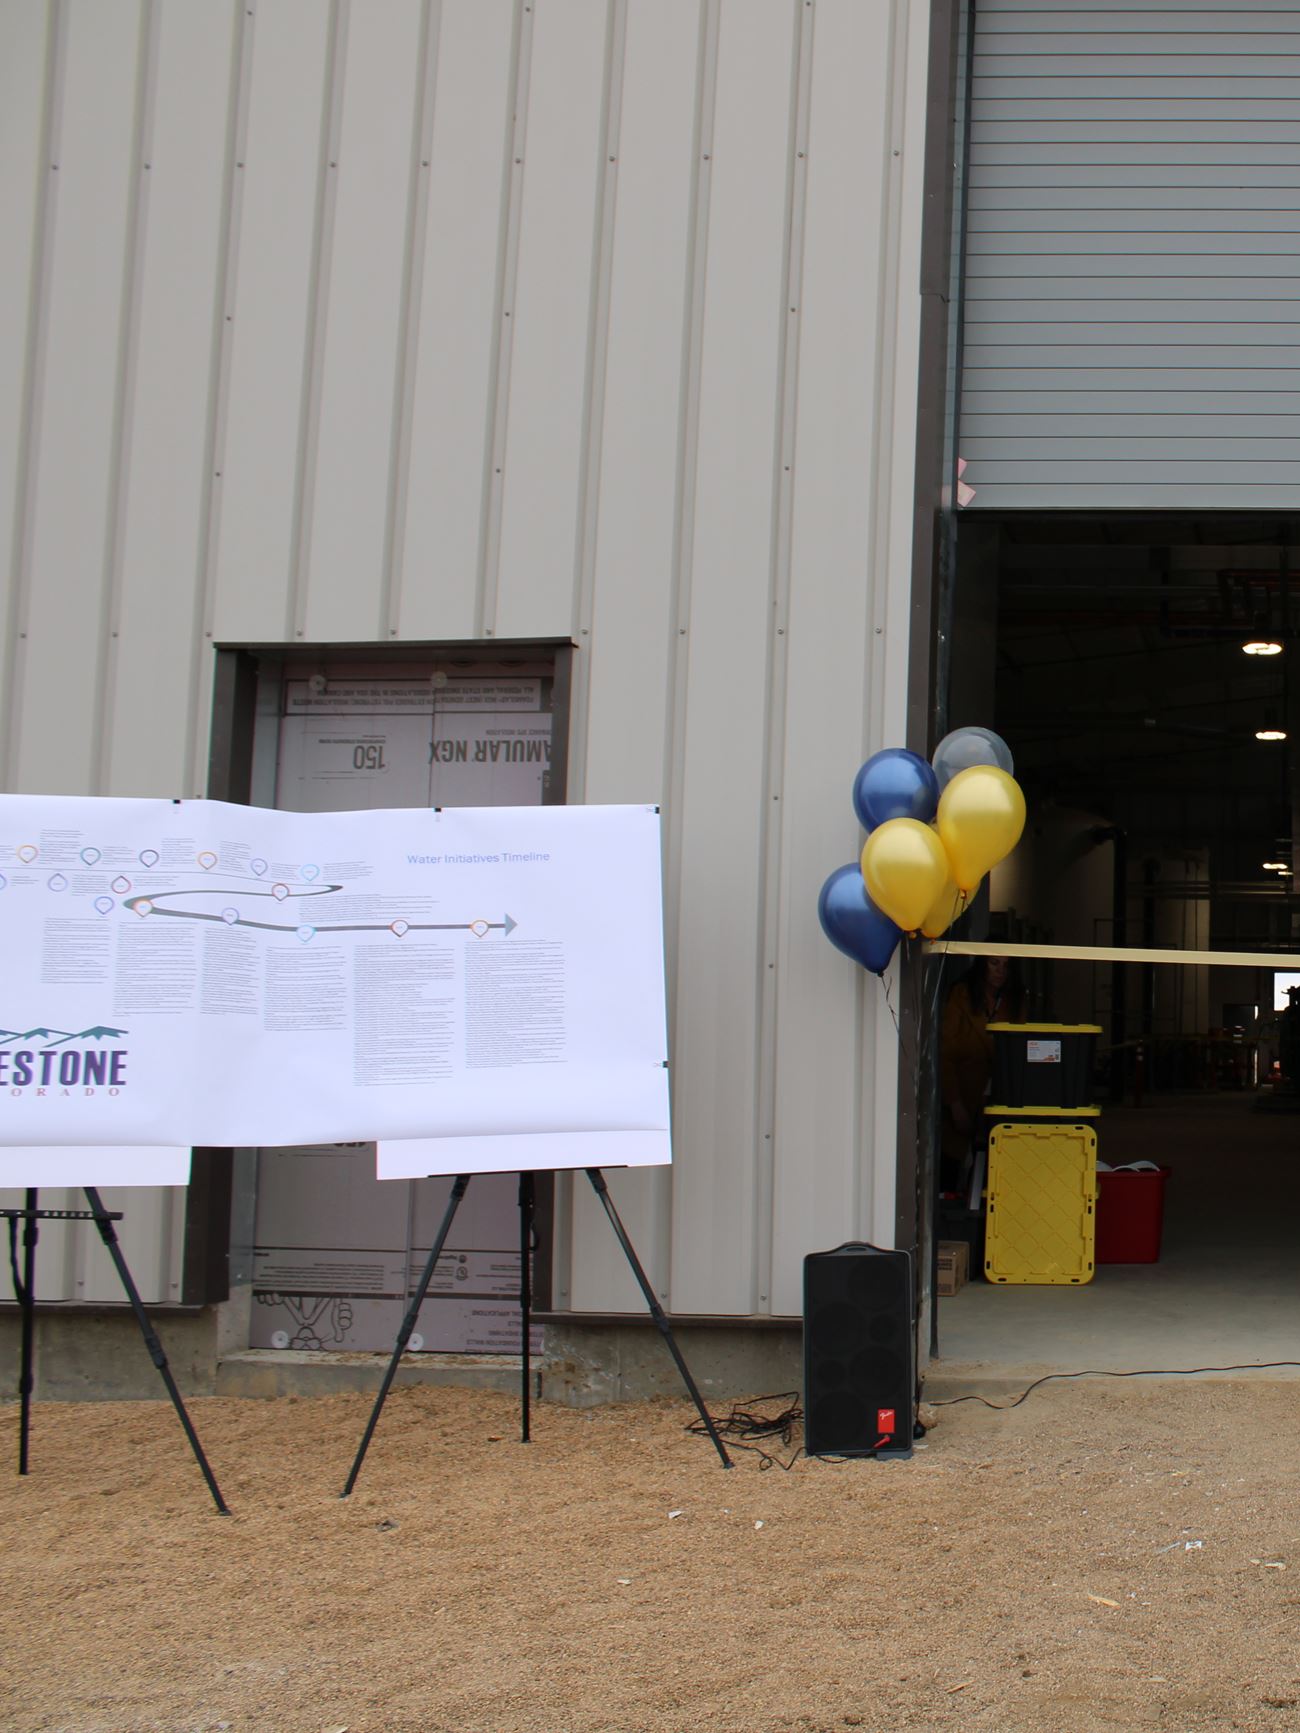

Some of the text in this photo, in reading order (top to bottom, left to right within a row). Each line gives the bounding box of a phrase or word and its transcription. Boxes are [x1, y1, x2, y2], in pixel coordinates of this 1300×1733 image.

[353, 745, 386, 770] 150
[429, 739, 468, 764] NGX
[407, 851, 551, 865] Water Initiatives Timeline
[11, 1087, 120, 1097] ORADO
